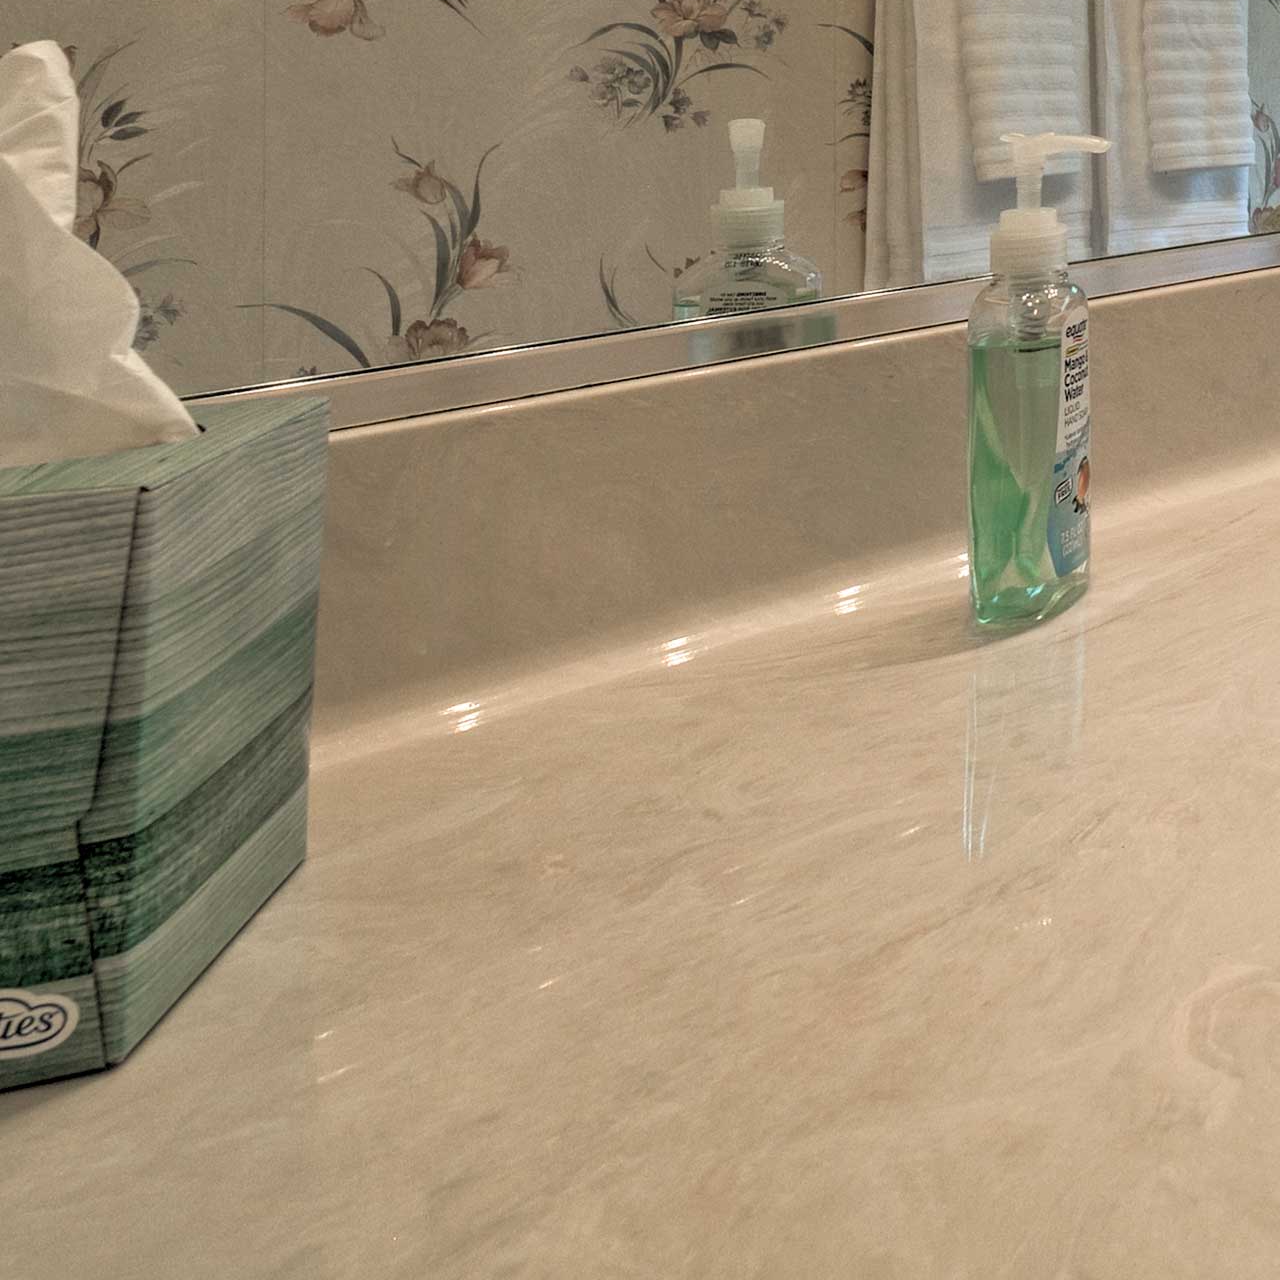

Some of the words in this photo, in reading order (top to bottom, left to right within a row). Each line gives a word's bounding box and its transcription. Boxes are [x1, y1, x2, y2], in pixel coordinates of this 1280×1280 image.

[1064, 354, 1085, 373] Mango
[1064, 383, 1084, 402] Water
[0, 1011, 59, 1039] ies
